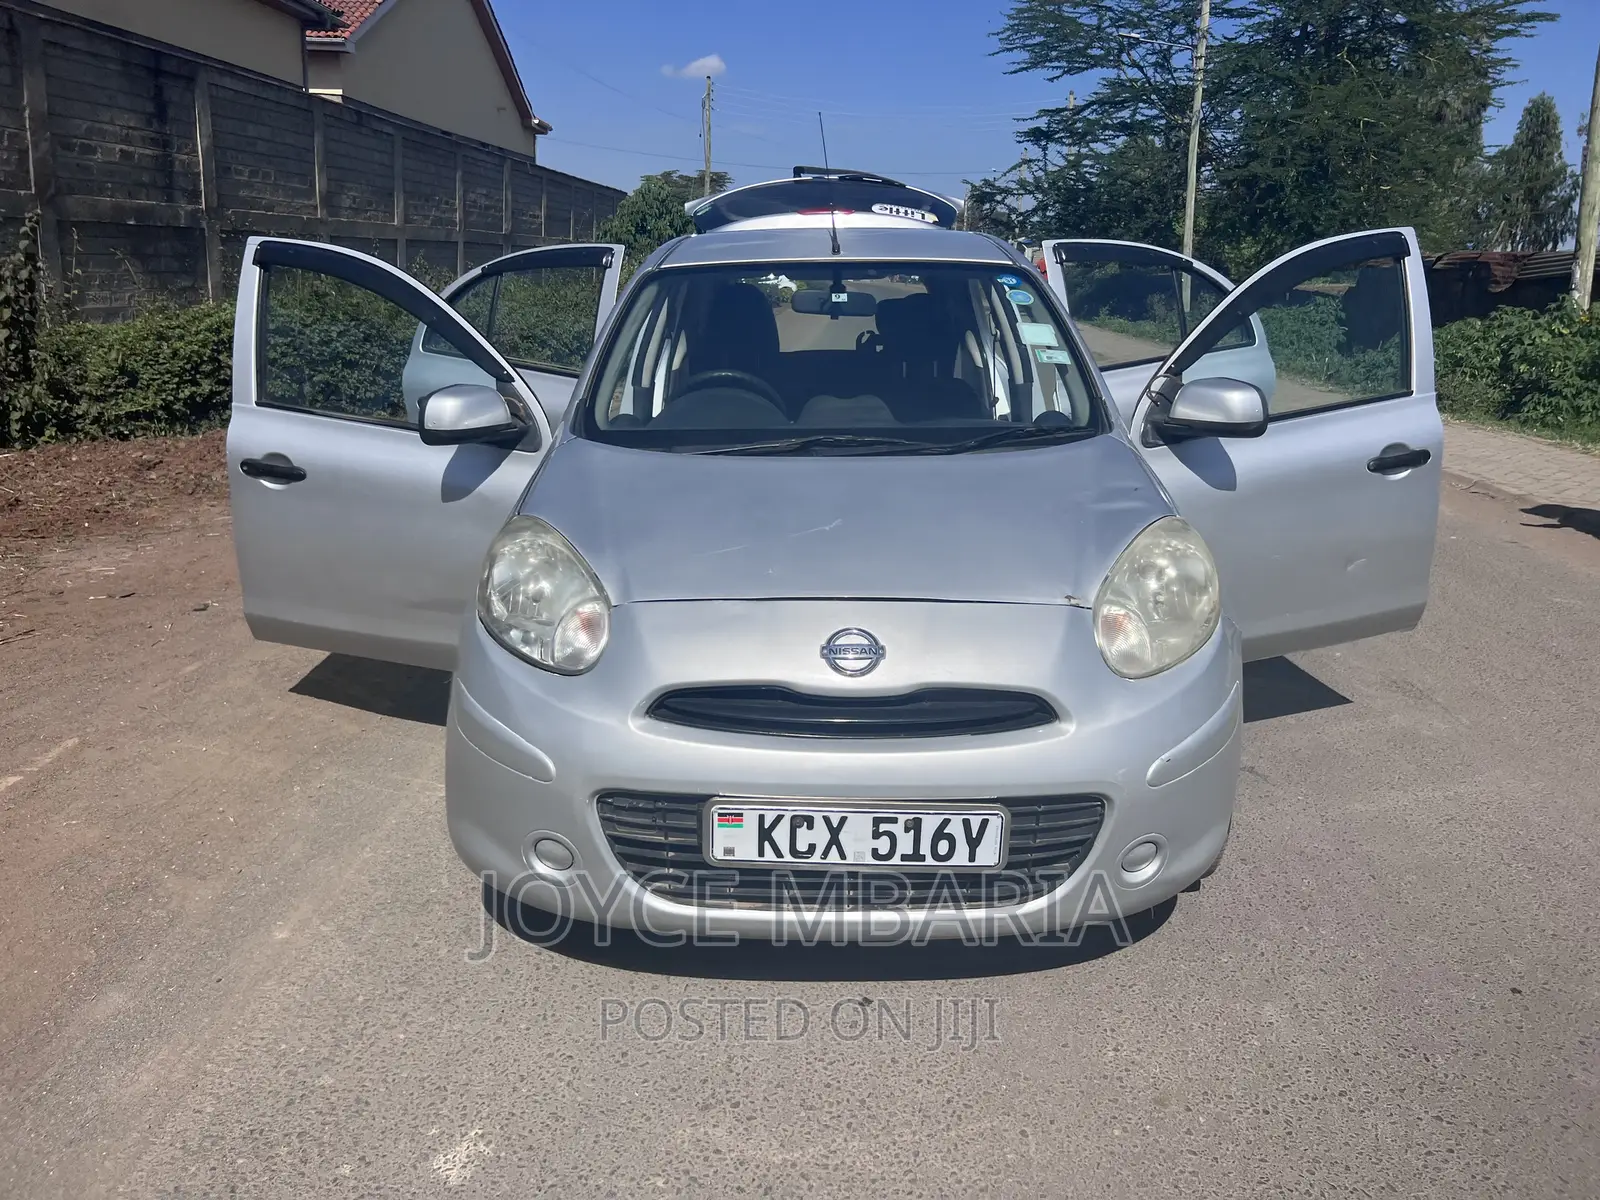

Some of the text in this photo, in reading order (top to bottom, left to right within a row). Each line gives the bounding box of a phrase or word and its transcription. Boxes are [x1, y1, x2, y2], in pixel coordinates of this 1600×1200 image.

[828, 647, 878, 656] NISSAN
[757, 813, 848, 860] KCX
[871, 816, 989, 863] 516Y
